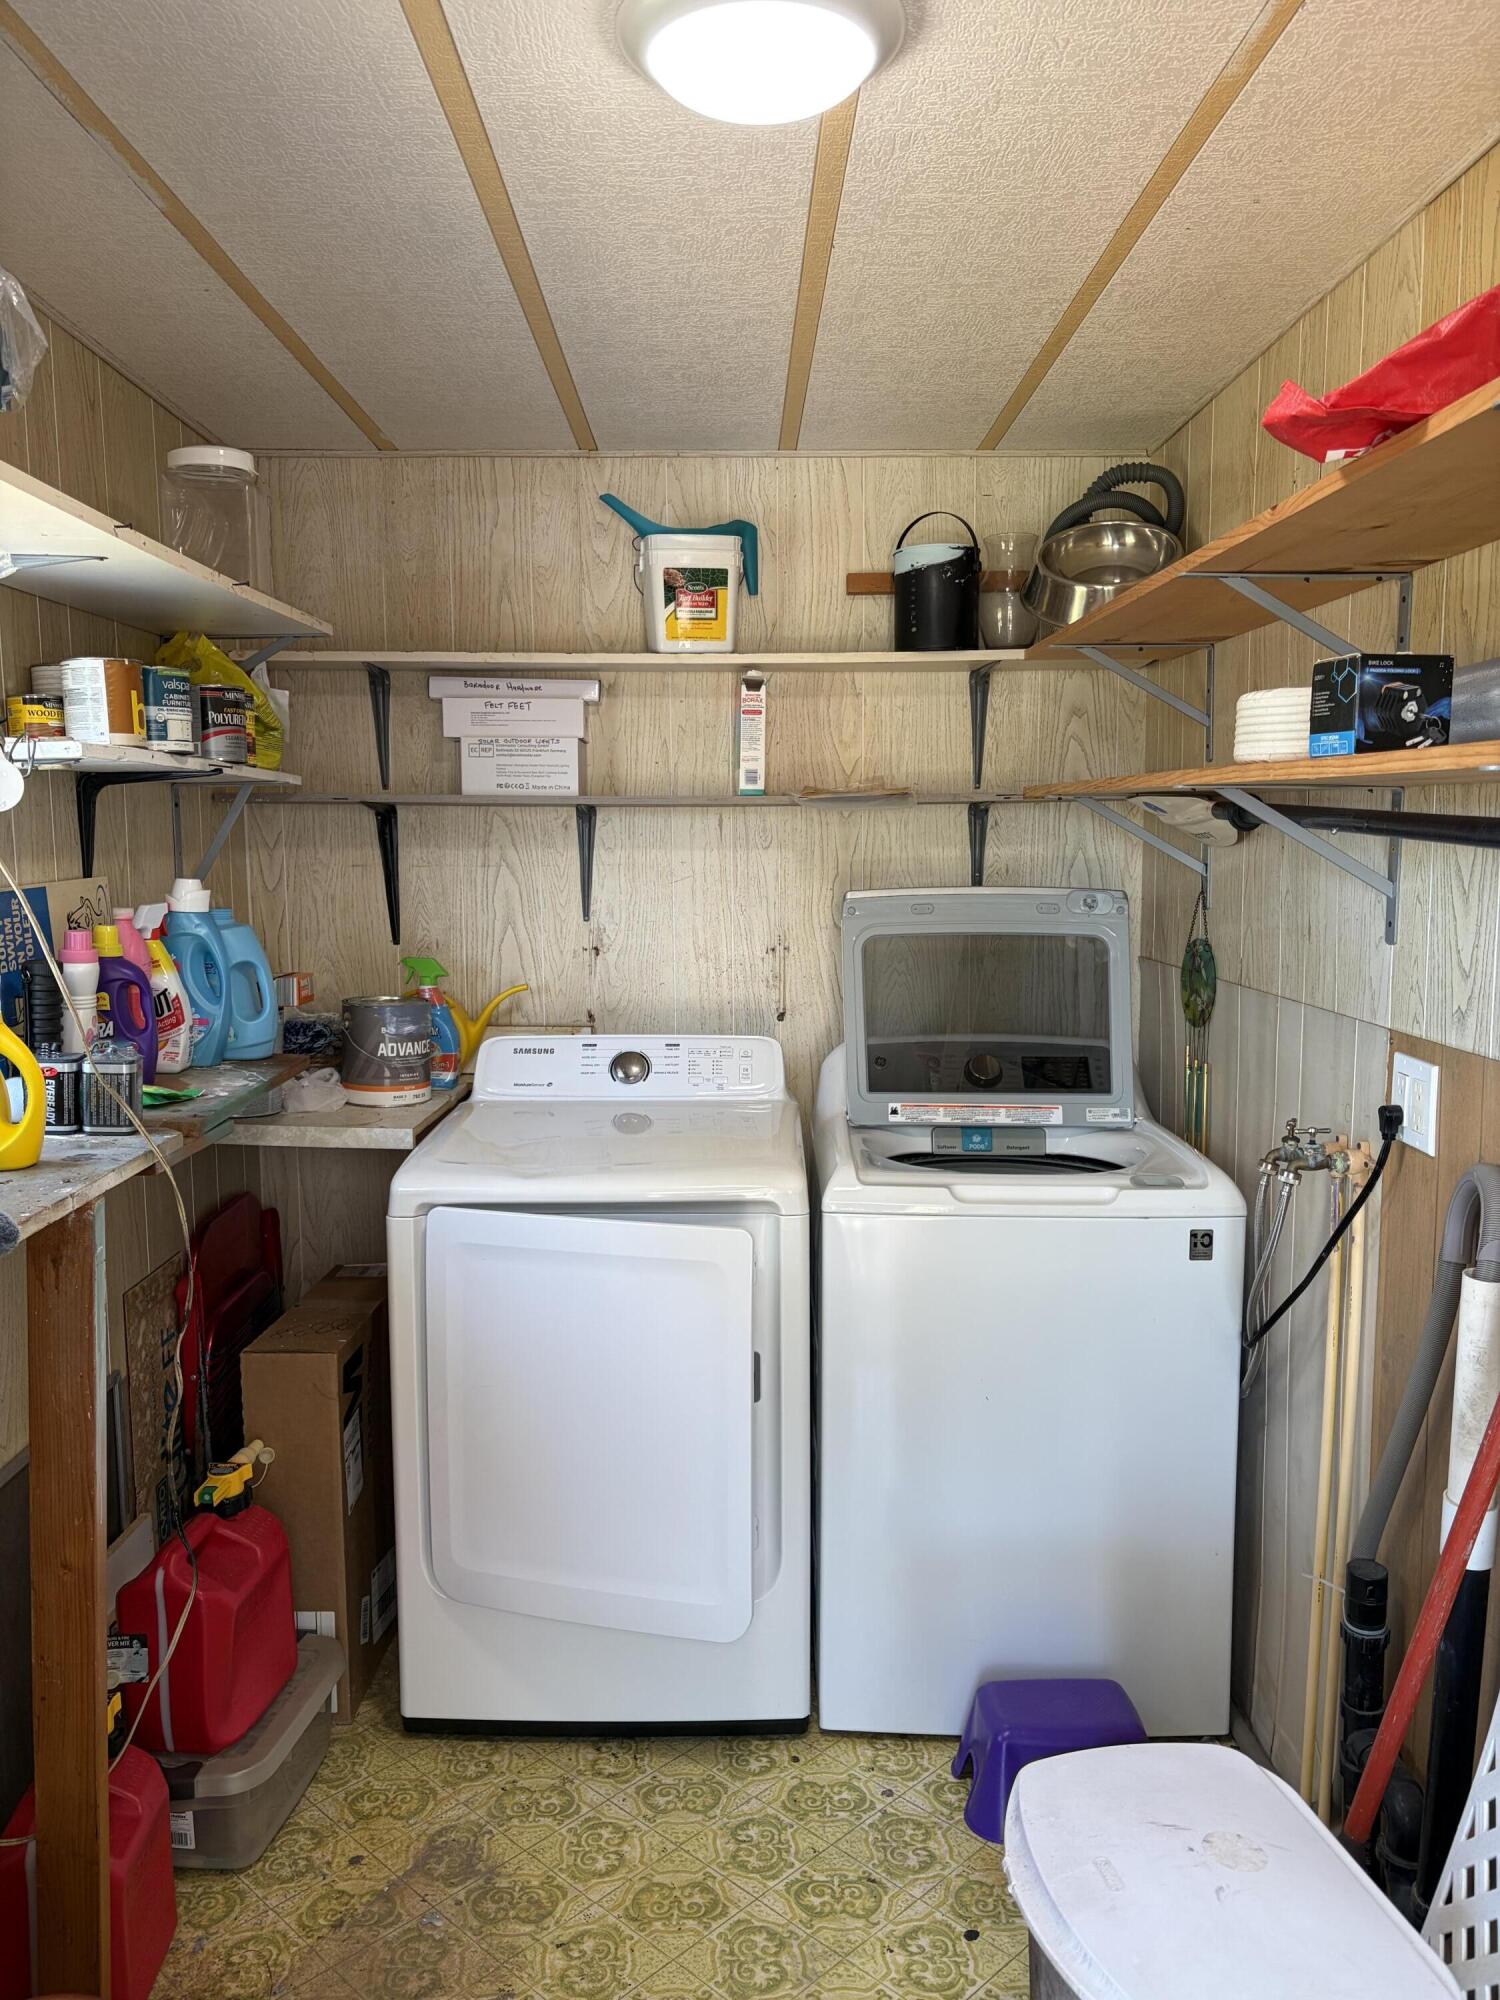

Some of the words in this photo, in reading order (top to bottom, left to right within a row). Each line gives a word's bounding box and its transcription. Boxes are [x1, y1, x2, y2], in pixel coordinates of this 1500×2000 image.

[162, 678, 190, 693] valspa
[28, 709, 56, 718] WOOD
[484, 701, 503, 710] FELT
[507, 701, 532, 711] FEET
[11, 898, 24, 947] YOUR
[21, 906, 35, 960] OILET
[4, 917, 17, 973] SWIM
[98, 1020, 114, 1039] RA
[377, 1039, 431, 1057] ADVANCE
[45, 1079, 56, 1125] EVEREADY
[107, 1640, 119, 1648] VER
